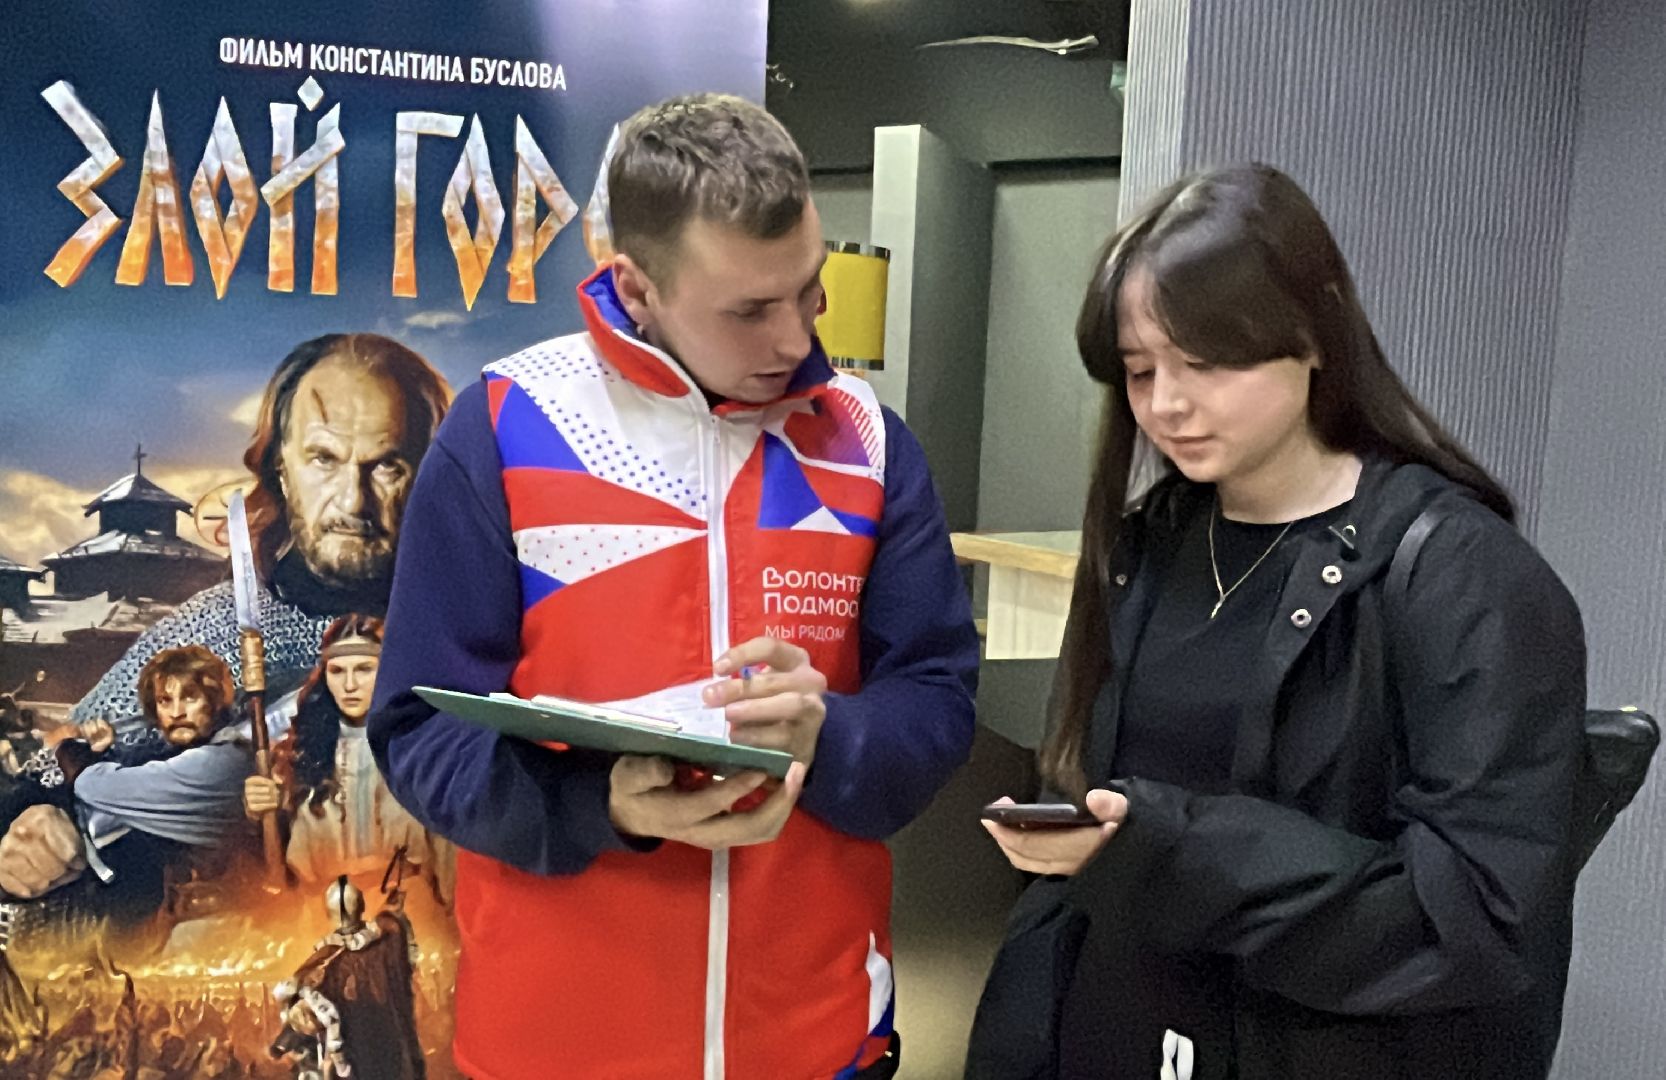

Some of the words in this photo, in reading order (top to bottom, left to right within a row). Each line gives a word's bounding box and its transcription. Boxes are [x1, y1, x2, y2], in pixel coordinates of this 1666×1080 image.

[219, 37, 303, 69] ФИЛЬМ
[309, 43, 465, 83] КОНСТАНТИНА
[470, 57, 567, 90] БУСЛОВА
[41, 75, 346, 300] ЗЛОЙ
[391, 111, 621, 312] ГОР
[764, 624, 796, 640] МЫ
[799, 624, 846, 642] РЯДОМ
